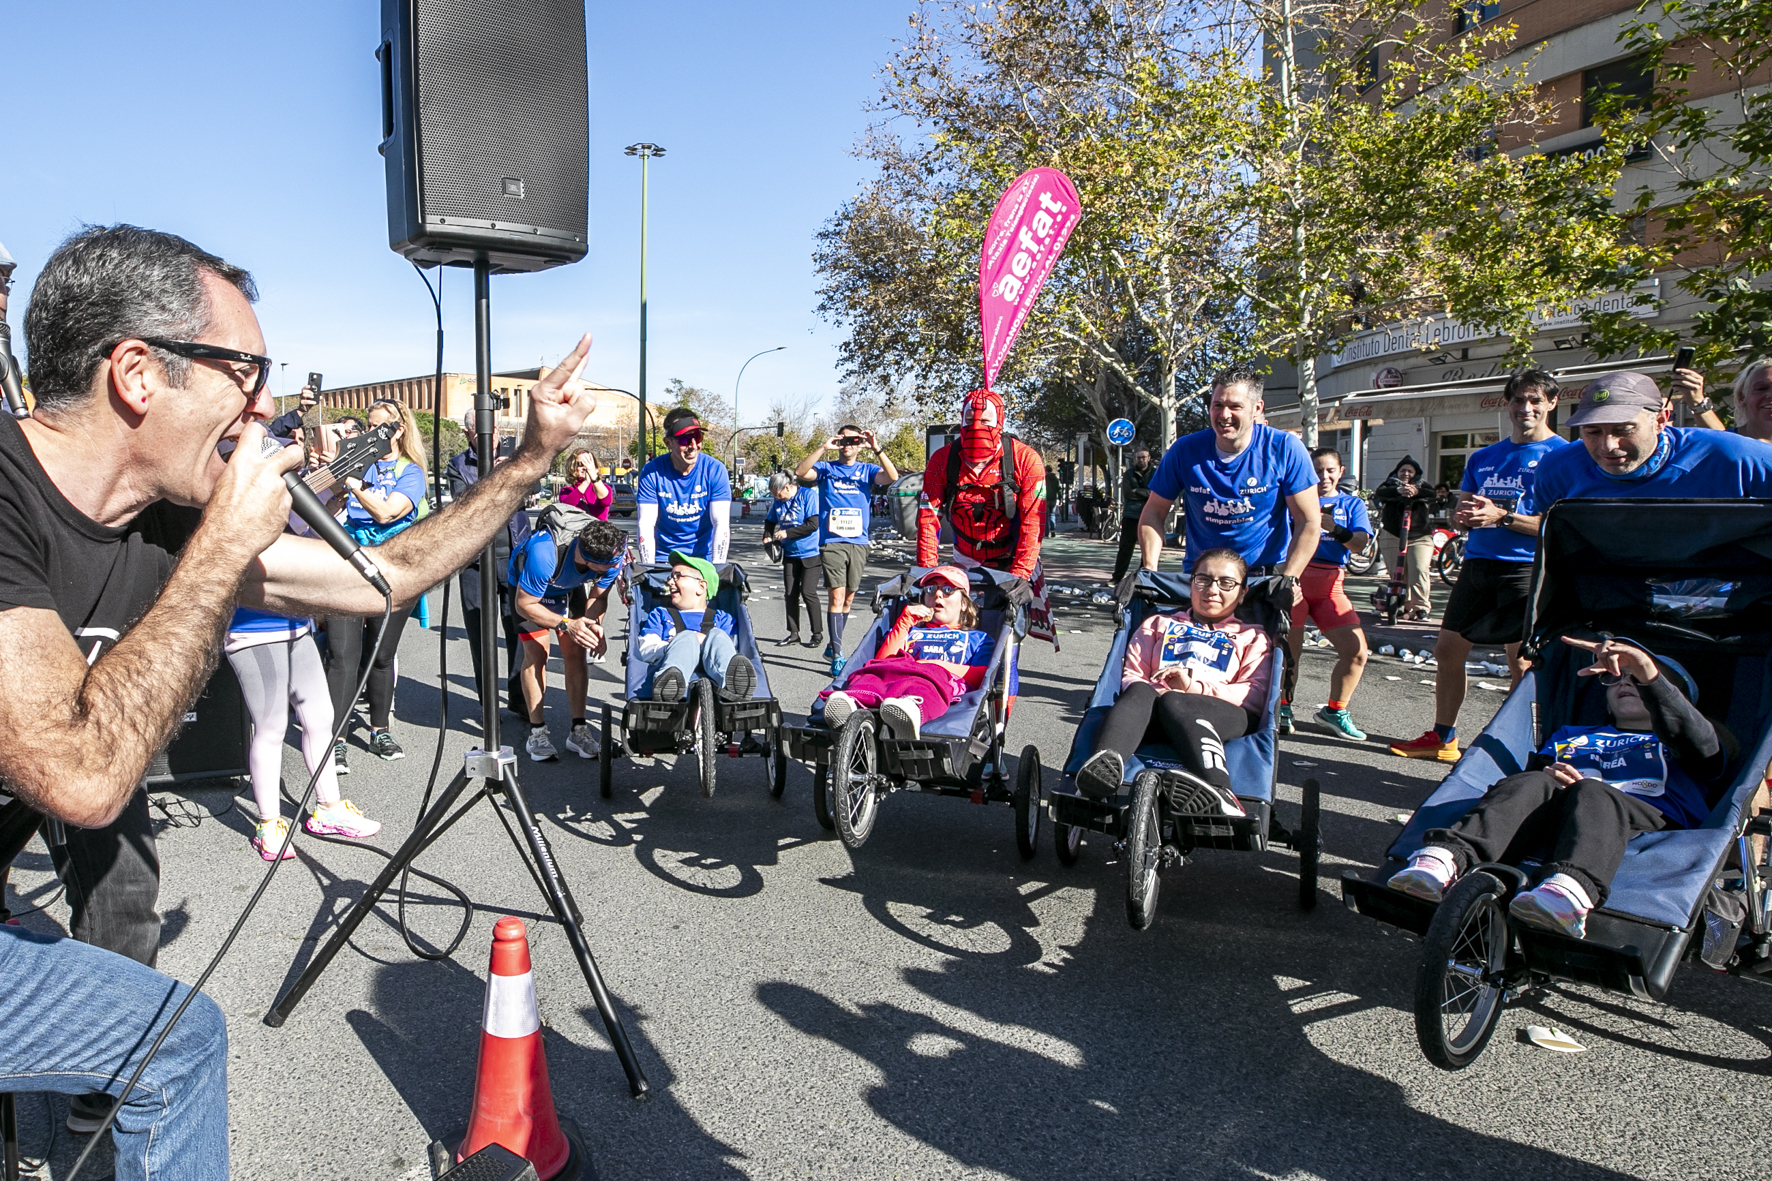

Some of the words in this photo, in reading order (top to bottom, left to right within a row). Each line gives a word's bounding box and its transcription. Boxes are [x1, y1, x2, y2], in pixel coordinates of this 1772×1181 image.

[998, 190, 1062, 303] aefat
[1024, 270, 1046, 306] BIZUM
[1045, 253, 1056, 269] AL
[1346, 340, 1380, 361] Instituto
[1517, 467, 1536, 475] ZURIC
[1238, 485, 1268, 496] ZURICH
[923, 644, 944, 654] SARA
[1594, 735, 1653, 748] ZURICH
[530, 825, 559, 879] Millenium
